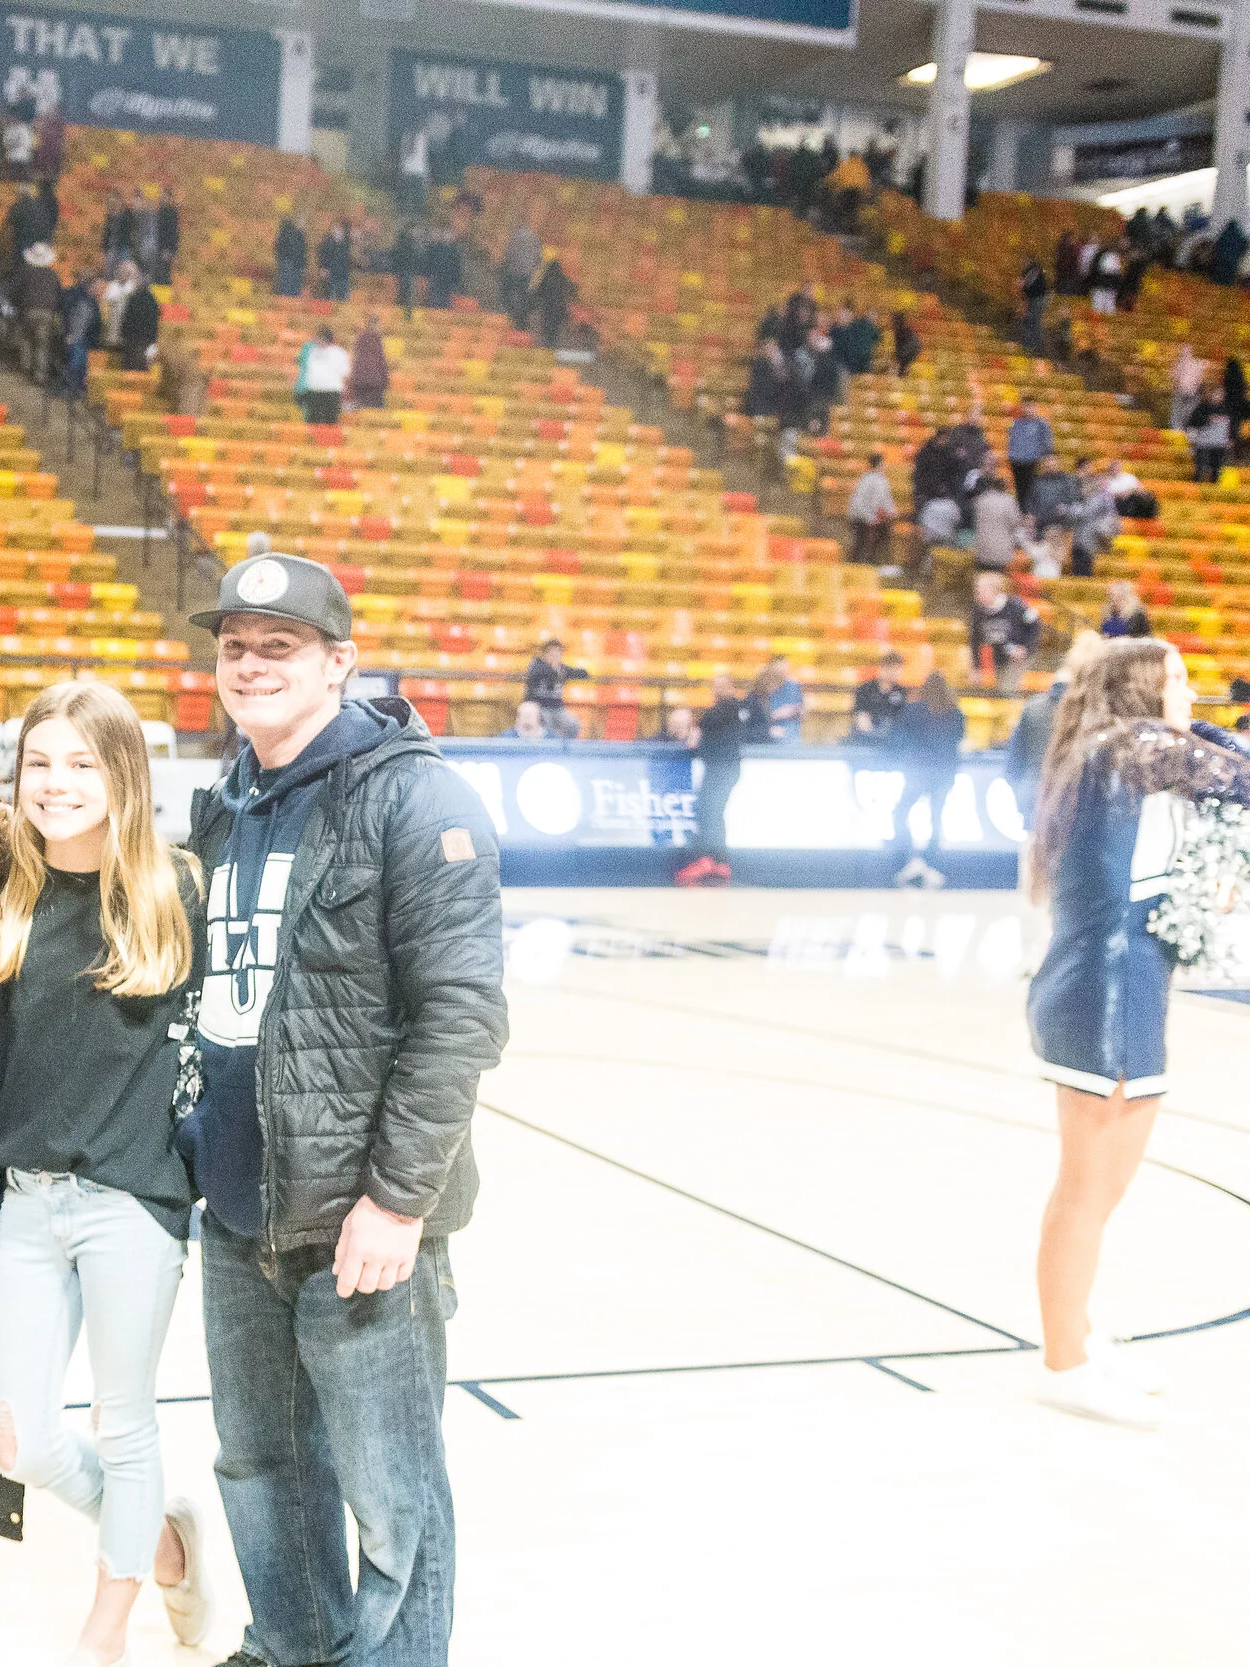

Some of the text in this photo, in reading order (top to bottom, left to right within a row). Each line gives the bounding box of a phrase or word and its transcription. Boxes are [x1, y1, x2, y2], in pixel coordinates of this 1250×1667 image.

[6, 15, 220, 75] THAT WE
[414, 63, 609, 118] WILL WIN
[588, 779, 697, 818] Fisher
